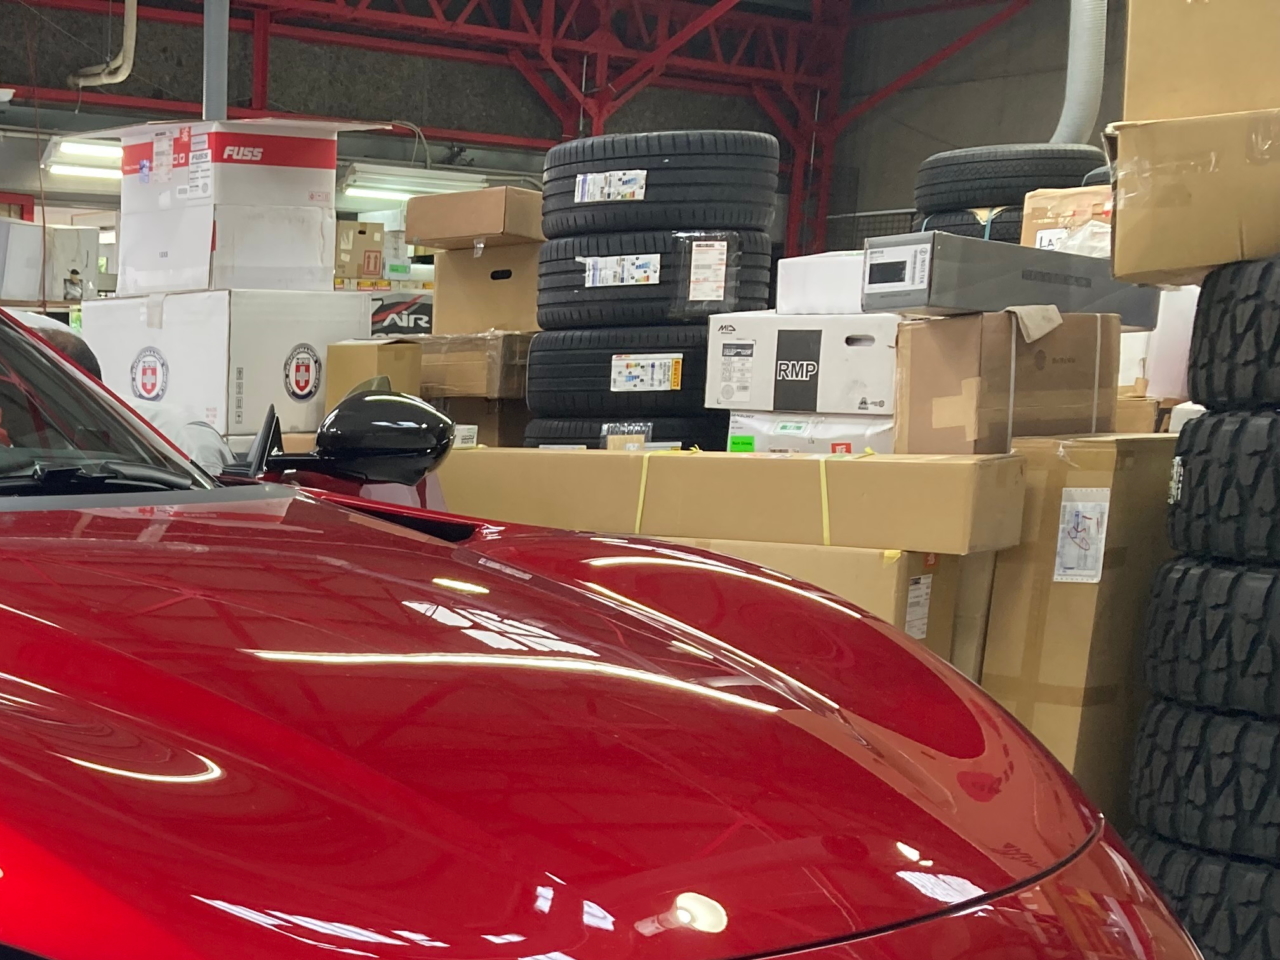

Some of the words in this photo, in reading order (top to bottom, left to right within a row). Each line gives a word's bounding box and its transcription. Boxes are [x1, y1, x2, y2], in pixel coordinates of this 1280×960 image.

[191, 152, 209, 161] FUSS
[223, 146, 264, 161] FUSS
[777, 361, 817, 380] RMP
